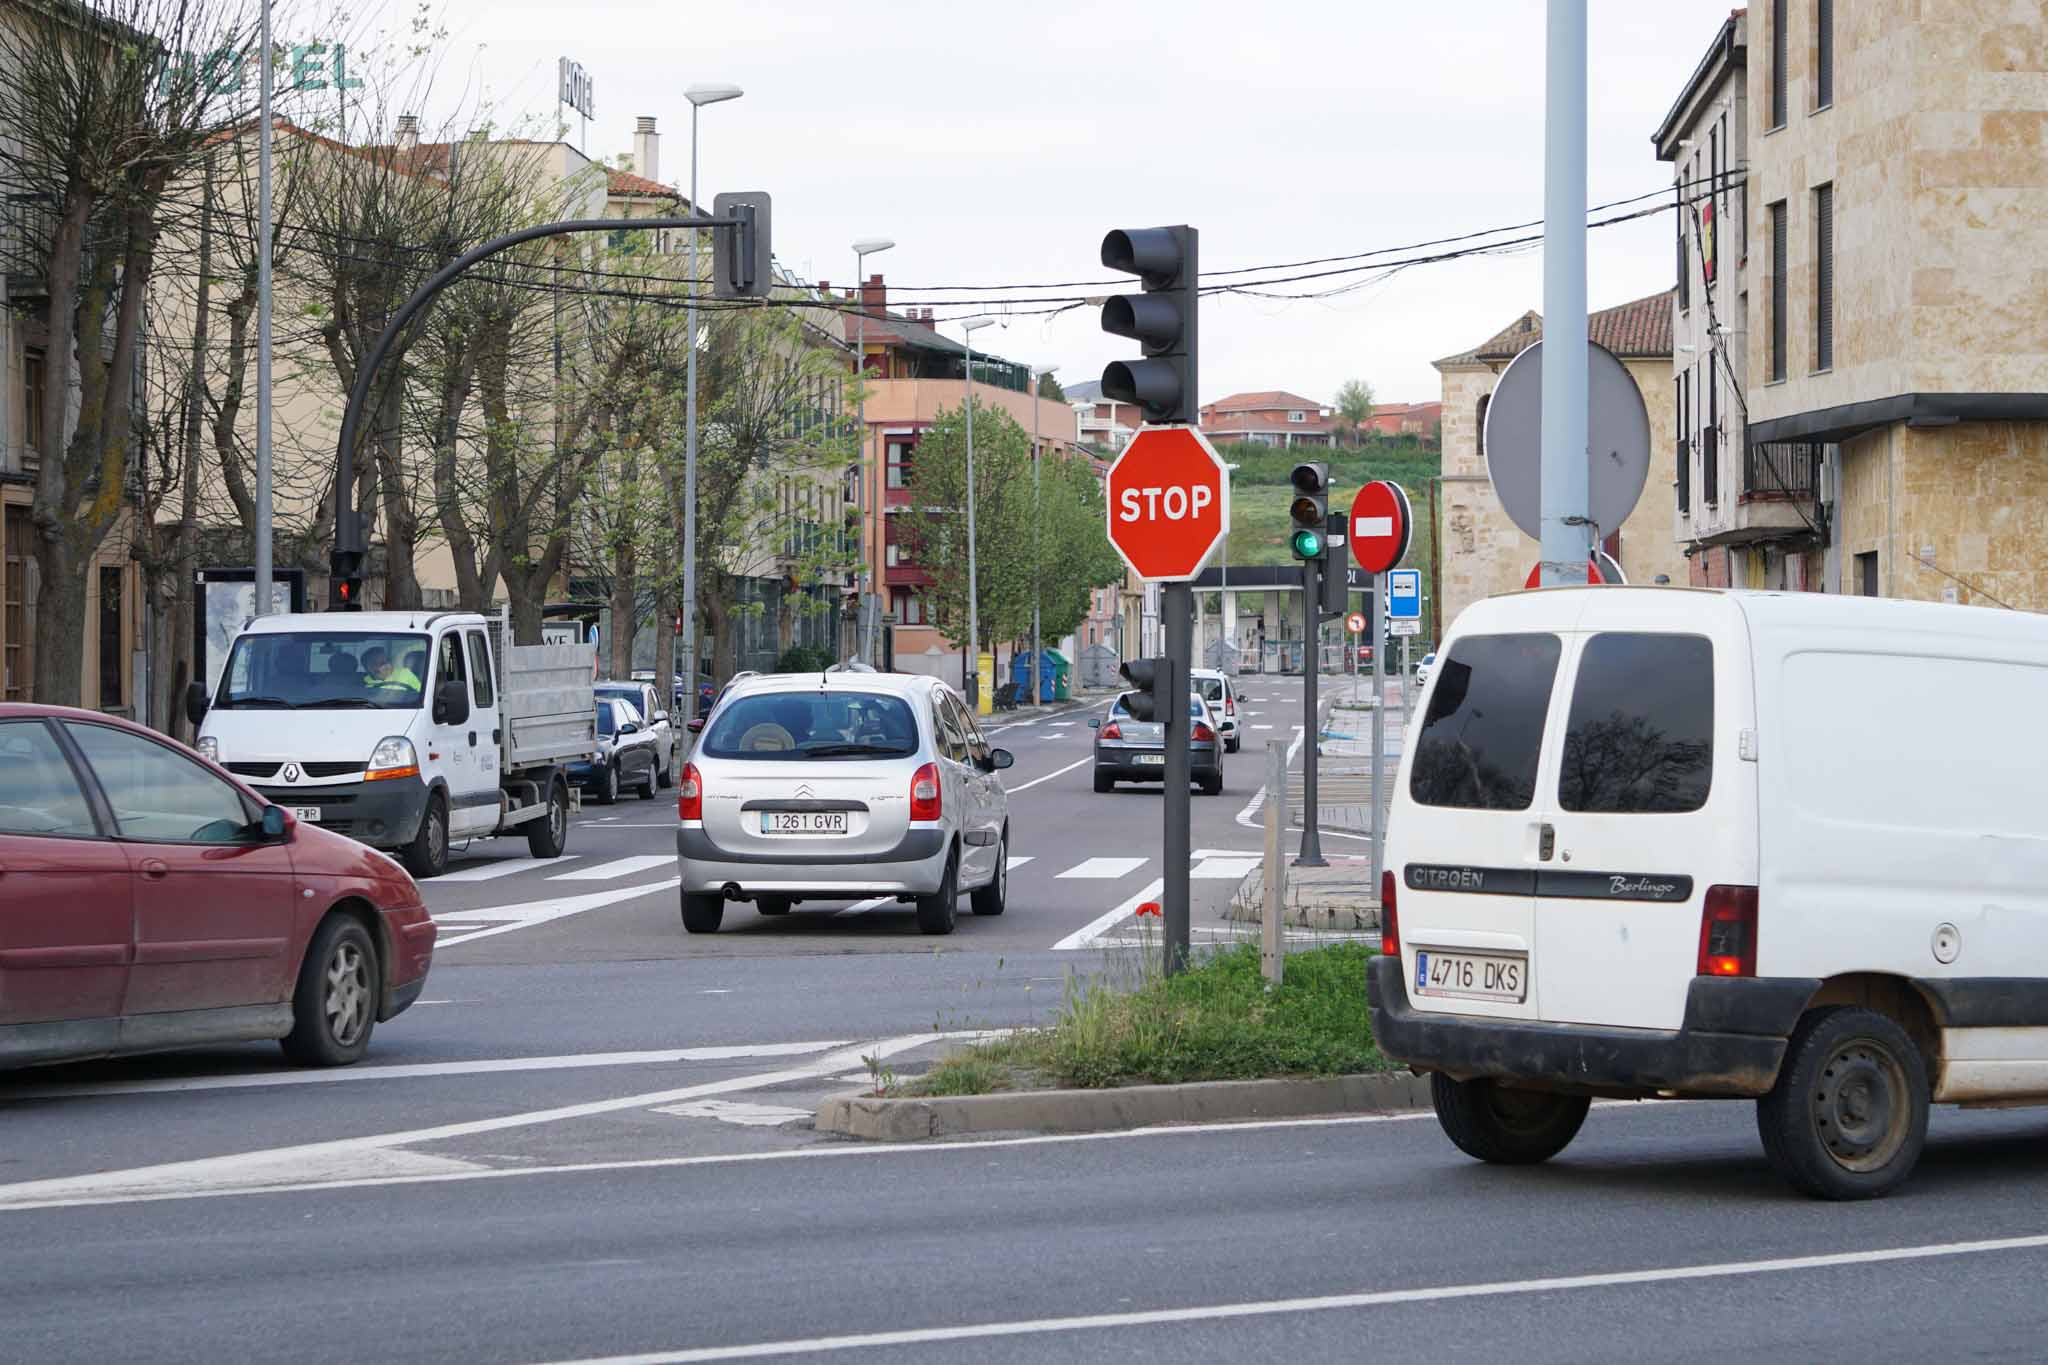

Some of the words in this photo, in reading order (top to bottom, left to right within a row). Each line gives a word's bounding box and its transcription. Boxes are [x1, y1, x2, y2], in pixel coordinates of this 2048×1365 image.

[159, 43, 365, 96] HOEL
[1119, 485, 1211, 522] STOP
[775, 815, 808, 829] 1261
[814, 815, 842, 829] GVR
[1414, 867, 1484, 888] CITROËN
[1609, 875, 1676, 898] Berlingo
[1431, 957, 1473, 988] 4716
[1484, 961, 1519, 991] DKS
